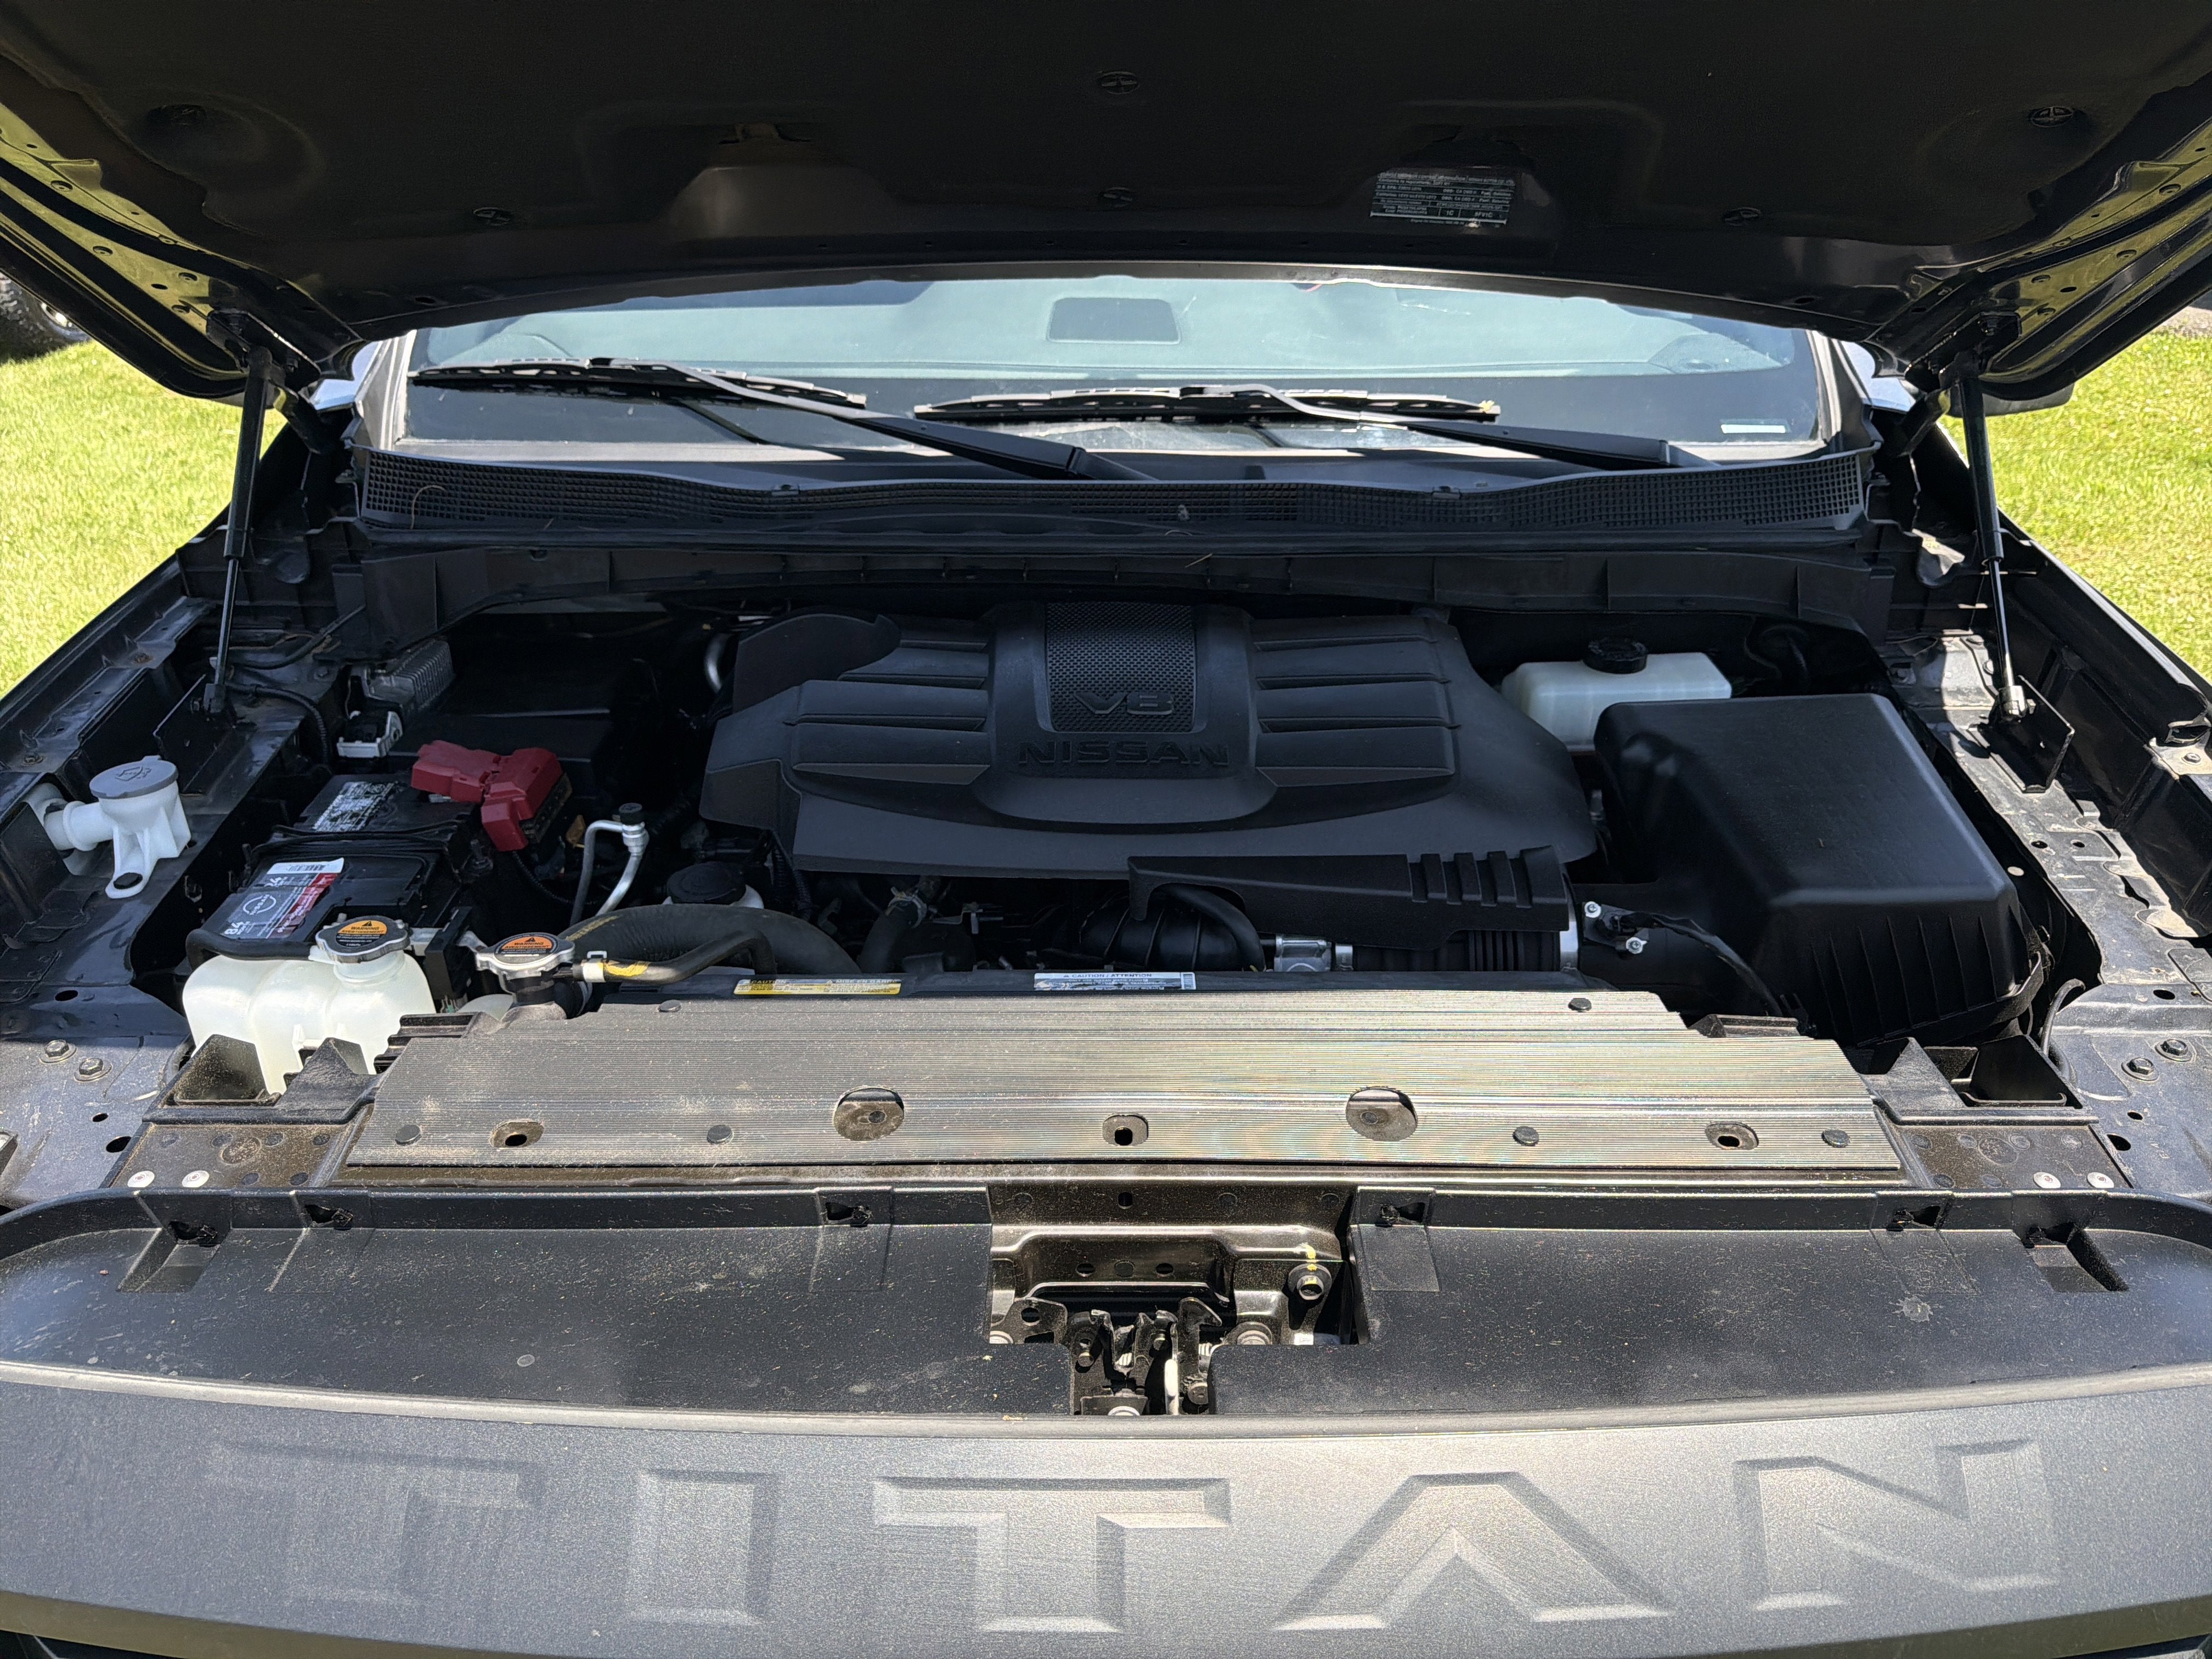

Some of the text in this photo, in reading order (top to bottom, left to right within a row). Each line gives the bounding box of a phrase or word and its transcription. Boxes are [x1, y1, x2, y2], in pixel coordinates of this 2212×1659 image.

[1074, 691, 1174, 715] V8
[1018, 741, 1229, 766] NISSAN
[199, 1438, 2063, 1634] TITAN
